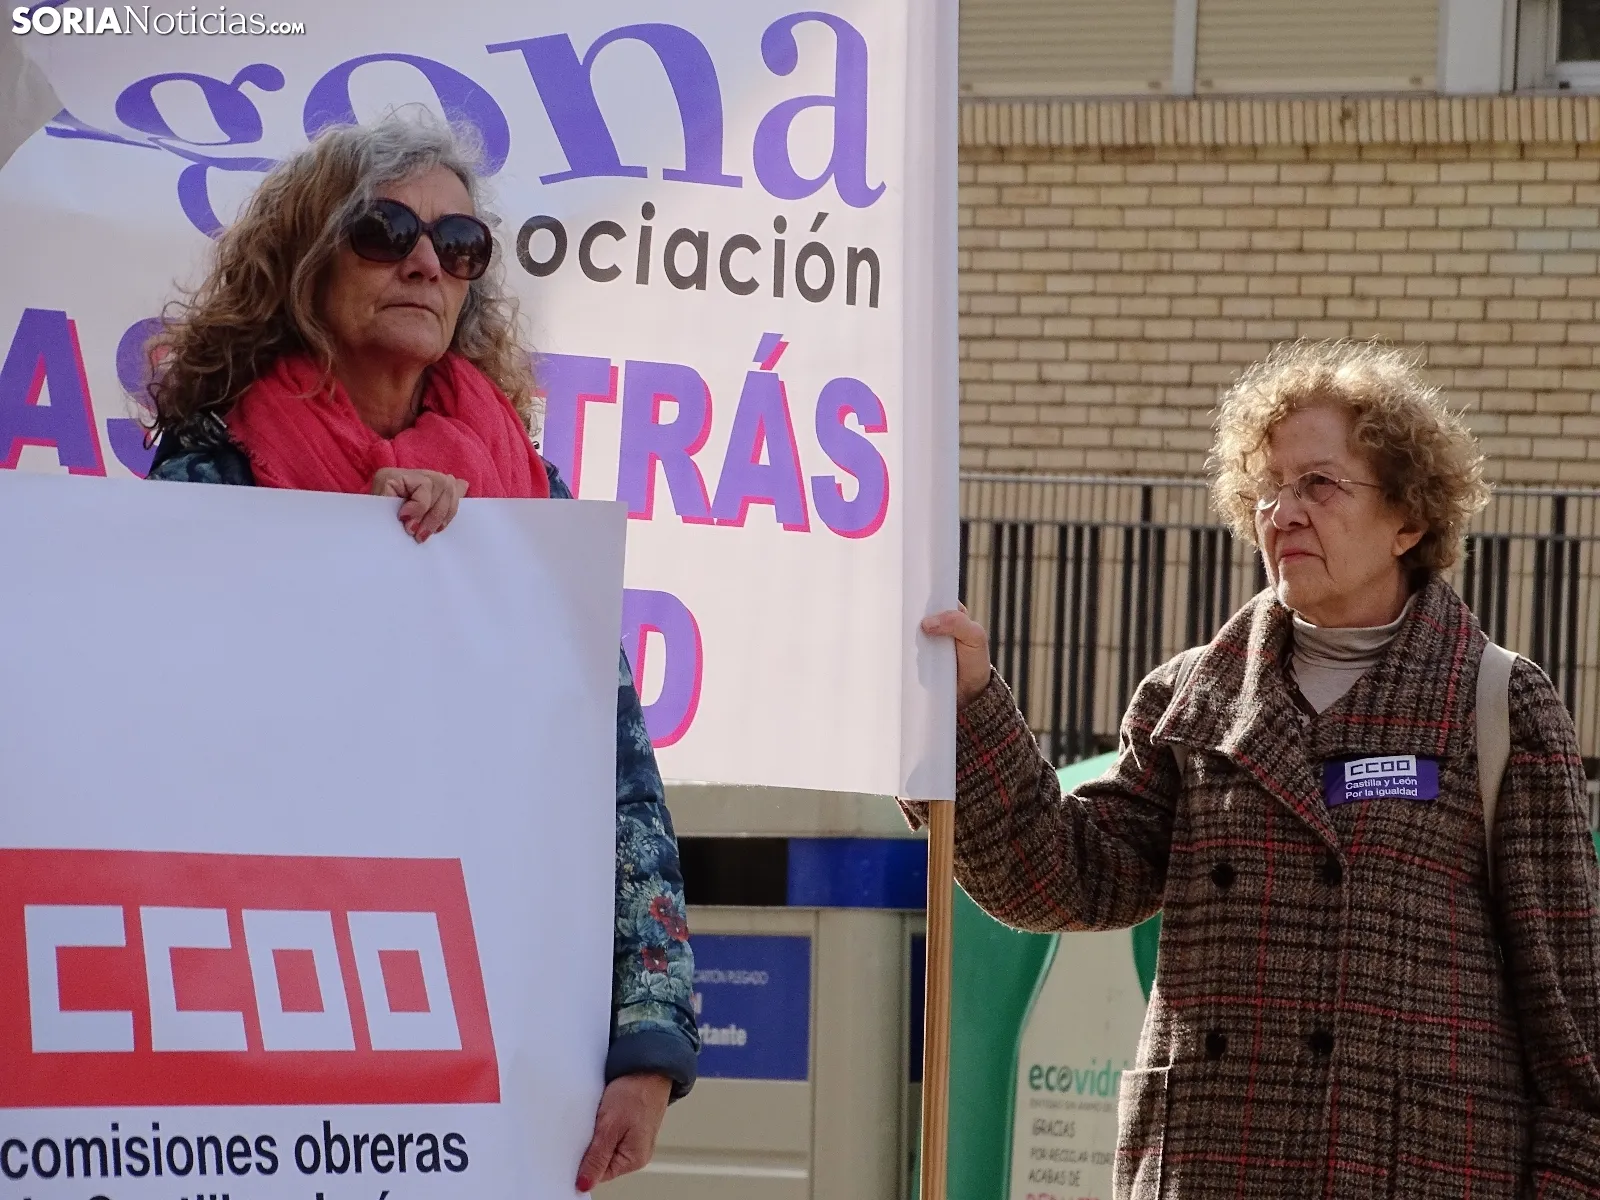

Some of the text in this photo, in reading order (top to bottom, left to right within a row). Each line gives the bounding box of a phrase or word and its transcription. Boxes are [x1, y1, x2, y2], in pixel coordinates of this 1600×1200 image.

[45, 11, 887, 240] gona
[488, 201, 881, 309] ociación
[532, 332, 889, 539] TRÁS
[1345, 776, 1418, 790] Castilla y León
[1345, 786, 1418, 799] Por la igualdad
[1350, 759, 1411, 776] CCOO
[23, 904, 463, 1053] CCOO
[1028, 1058, 1128, 1097] ecovidr
[0, 1120, 469, 1179] comisiones obreras
